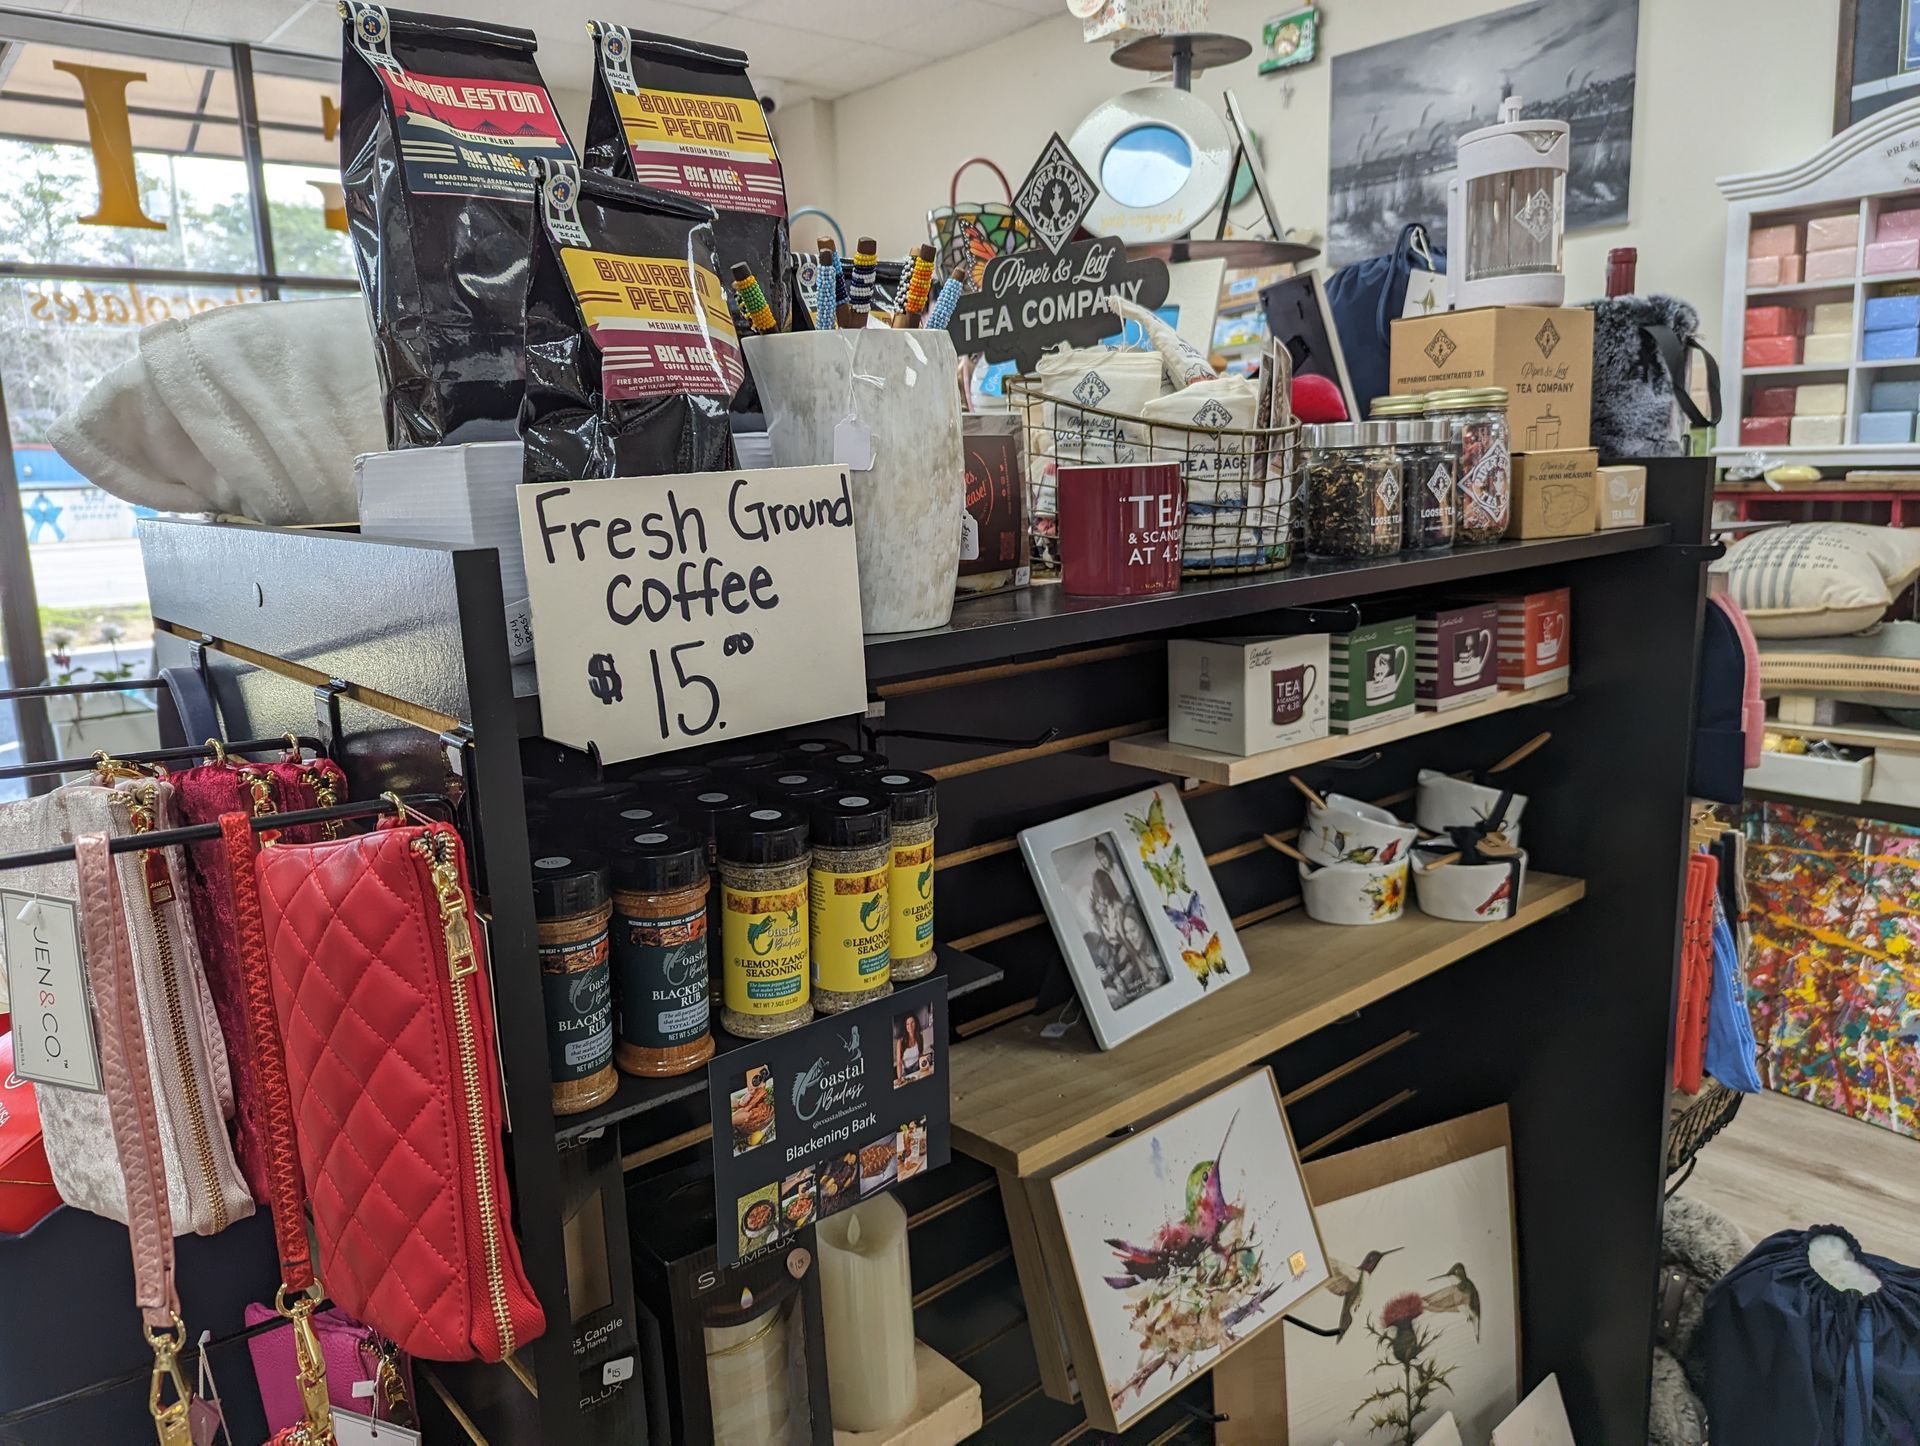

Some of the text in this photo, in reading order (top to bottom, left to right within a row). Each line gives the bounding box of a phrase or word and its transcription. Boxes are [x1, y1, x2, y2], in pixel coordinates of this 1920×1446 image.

[607, 71, 632, 82] WHOLE
[386, 69, 544, 114] CHARLESTON
[637, 94, 743, 123] BOURBON
[661, 116, 735, 145] PECAN
[469, 134, 488, 142] CITY
[488, 137, 515, 146] BLEND
[458, 145, 489, 165] BIG
[678, 144, 731, 158] MEDIUM ROAST
[467, 161, 527, 177] COFFEE ROASTERS
[682, 164, 744, 187] BIG KICK
[423, 172, 438, 180] FIRE
[438, 173, 468, 182] ROASTED
[487, 177, 513, 187] ARABICA
[512, 181, 534, 189] WHOLE
[689, 180, 742, 193] COFFEE ROASTERS
[1031, 164, 1081, 207] PIPER & LEAF
[706, 192, 729, 200] ARABICA
[760, 198, 777, 206] COFFEE
[550, 222, 581, 231] WHOLE
[1036, 211, 1056, 234] TEA
[558, 231, 581, 239] BEAN
[992, 243, 1117, 300] Piper & Leaf
[624, 286, 703, 317] PECA
[959, 278, 1144, 341] TEA COMPANY
[647, 321, 681, 331] MEDIUM
[653, 344, 686, 363] BIG
[663, 363, 690, 371] COFFEE
[1521, 361, 1545, 379] Piper
[1554, 361, 1571, 381] Leaf
[616, 377, 632, 386] FIRE
[632, 375, 665, 384] ROASTED
[684, 375, 711, 383] ARABICA
[1397, 370, 1485, 385] PREPARING CONCENTRATED TEA
[1515, 382, 1575, 394] TEA COMPANY
[1099, 429, 1125, 442] TEA
[1178, 457, 1247, 473] TEA BAGS
[1538, 471, 1593, 481] OZ MINI MEASURE
[534, 473, 853, 564] Fresh Ground
[1420, 506, 1456, 519] LOOSE TEA
[1370, 515, 1392, 527] LOOSE
[1127, 532, 1138, 544] &
[1127, 547, 1156, 566] AT
[510, 619, 524, 647] Sexy
[1276, 679, 1301, 698] TEA
[1276, 704, 1286, 713] AT
[853, 932, 884, 947] LEMON
[741, 958, 779, 969] LEMON
[745, 961, 803, 978] SEASONING
[680, 991, 701, 1008] RUB
[588, 1018, 607, 1036] RUB
[669, 1021, 690, 1030] TOTAL
[668, 1032, 679, 1041] NET
[575, 1050, 599, 1061] TOTAL
[576, 1063, 587, 1073] NET
[820, 1081, 865, 1111] Badass
[812, 1100, 868, 1130] @coastalbadassco
[785, 1112, 878, 1163] Blackening Bark
[730, 1234, 796, 1270] SIMPLUX
[584, 1318, 623, 1342] Candle
[586, 1335, 608, 1350] flame
[607, 1367, 621, 1378] $15
[579, 1381, 623, 1409] PLUX
